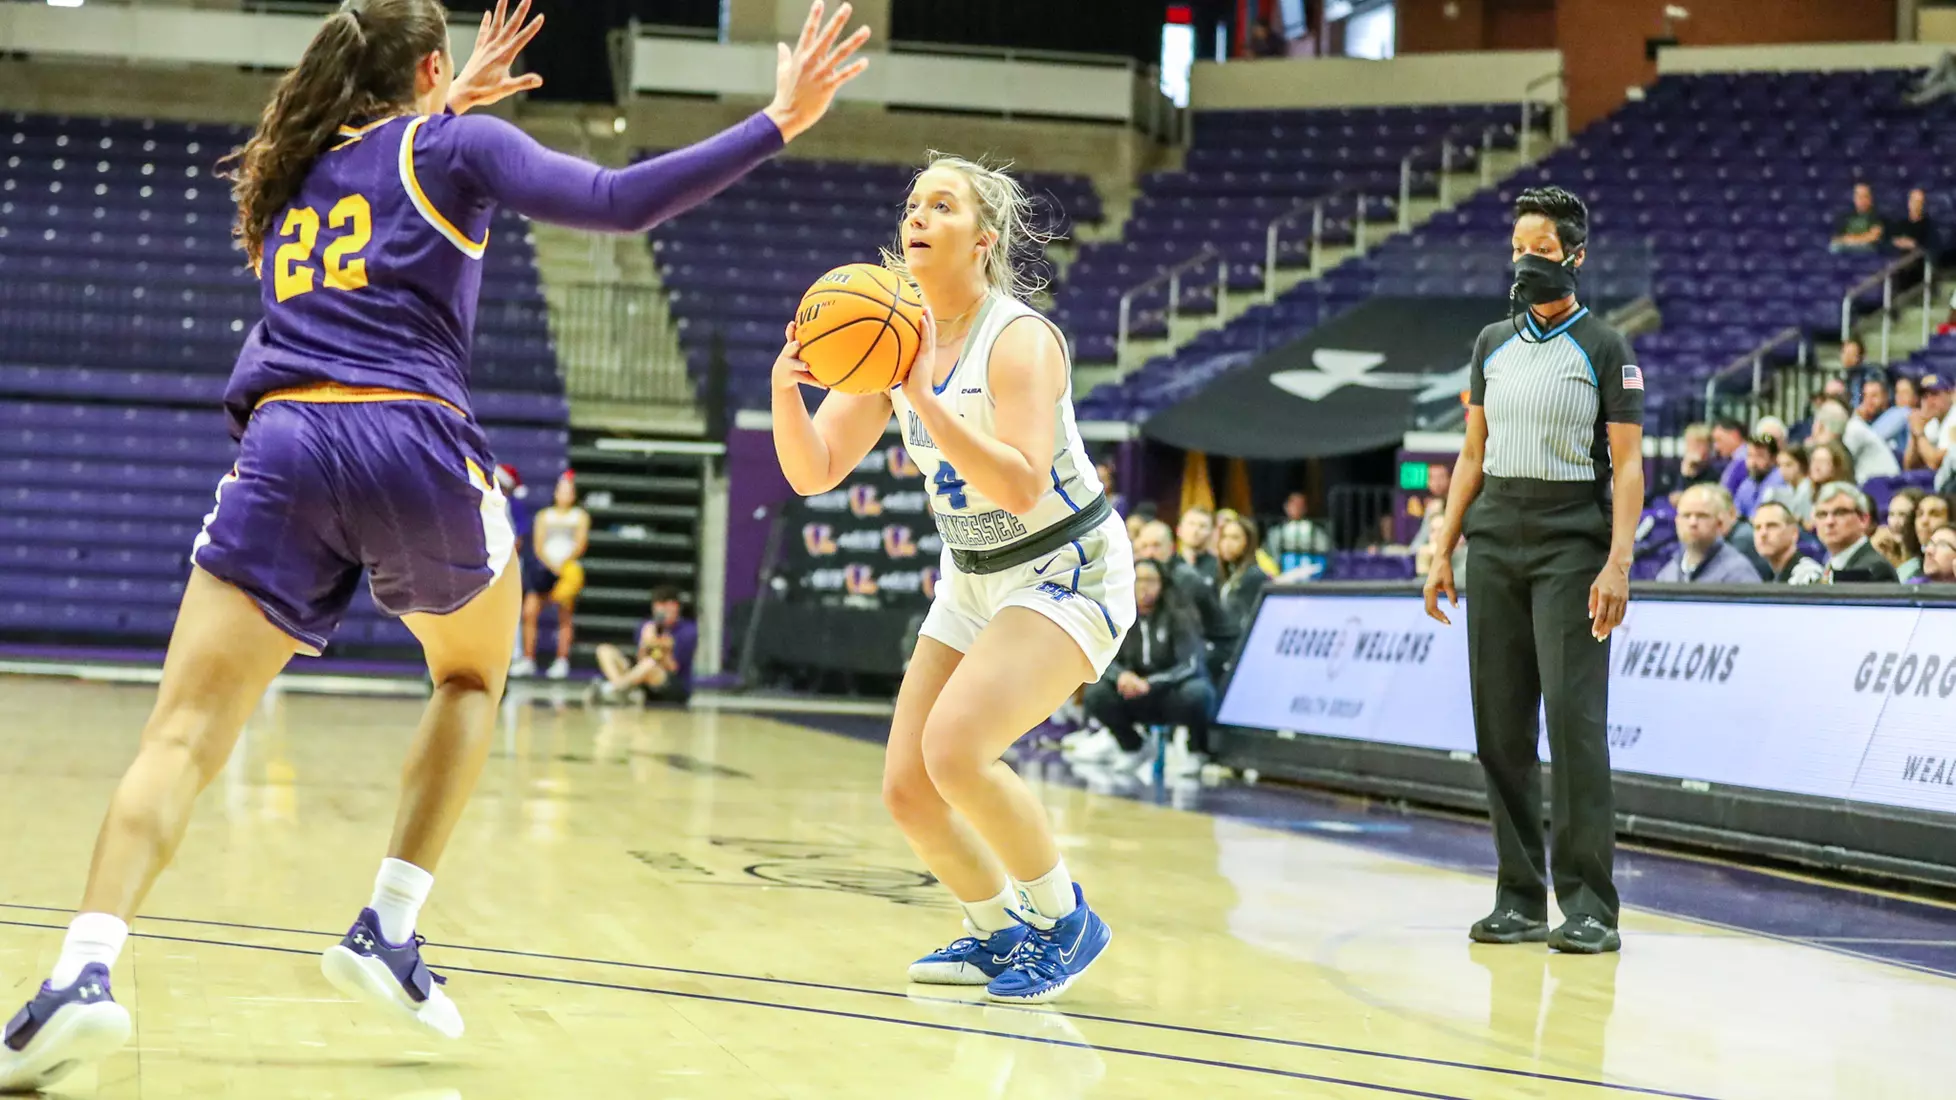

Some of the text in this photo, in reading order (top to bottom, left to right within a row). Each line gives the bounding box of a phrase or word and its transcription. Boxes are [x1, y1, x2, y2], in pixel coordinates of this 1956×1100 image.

[274, 193, 372, 303] 22
[933, 460, 968, 510] 4
[1275, 627, 1434, 665] GEORGE WELLONS
[1621, 640, 1740, 683] WELLONS
